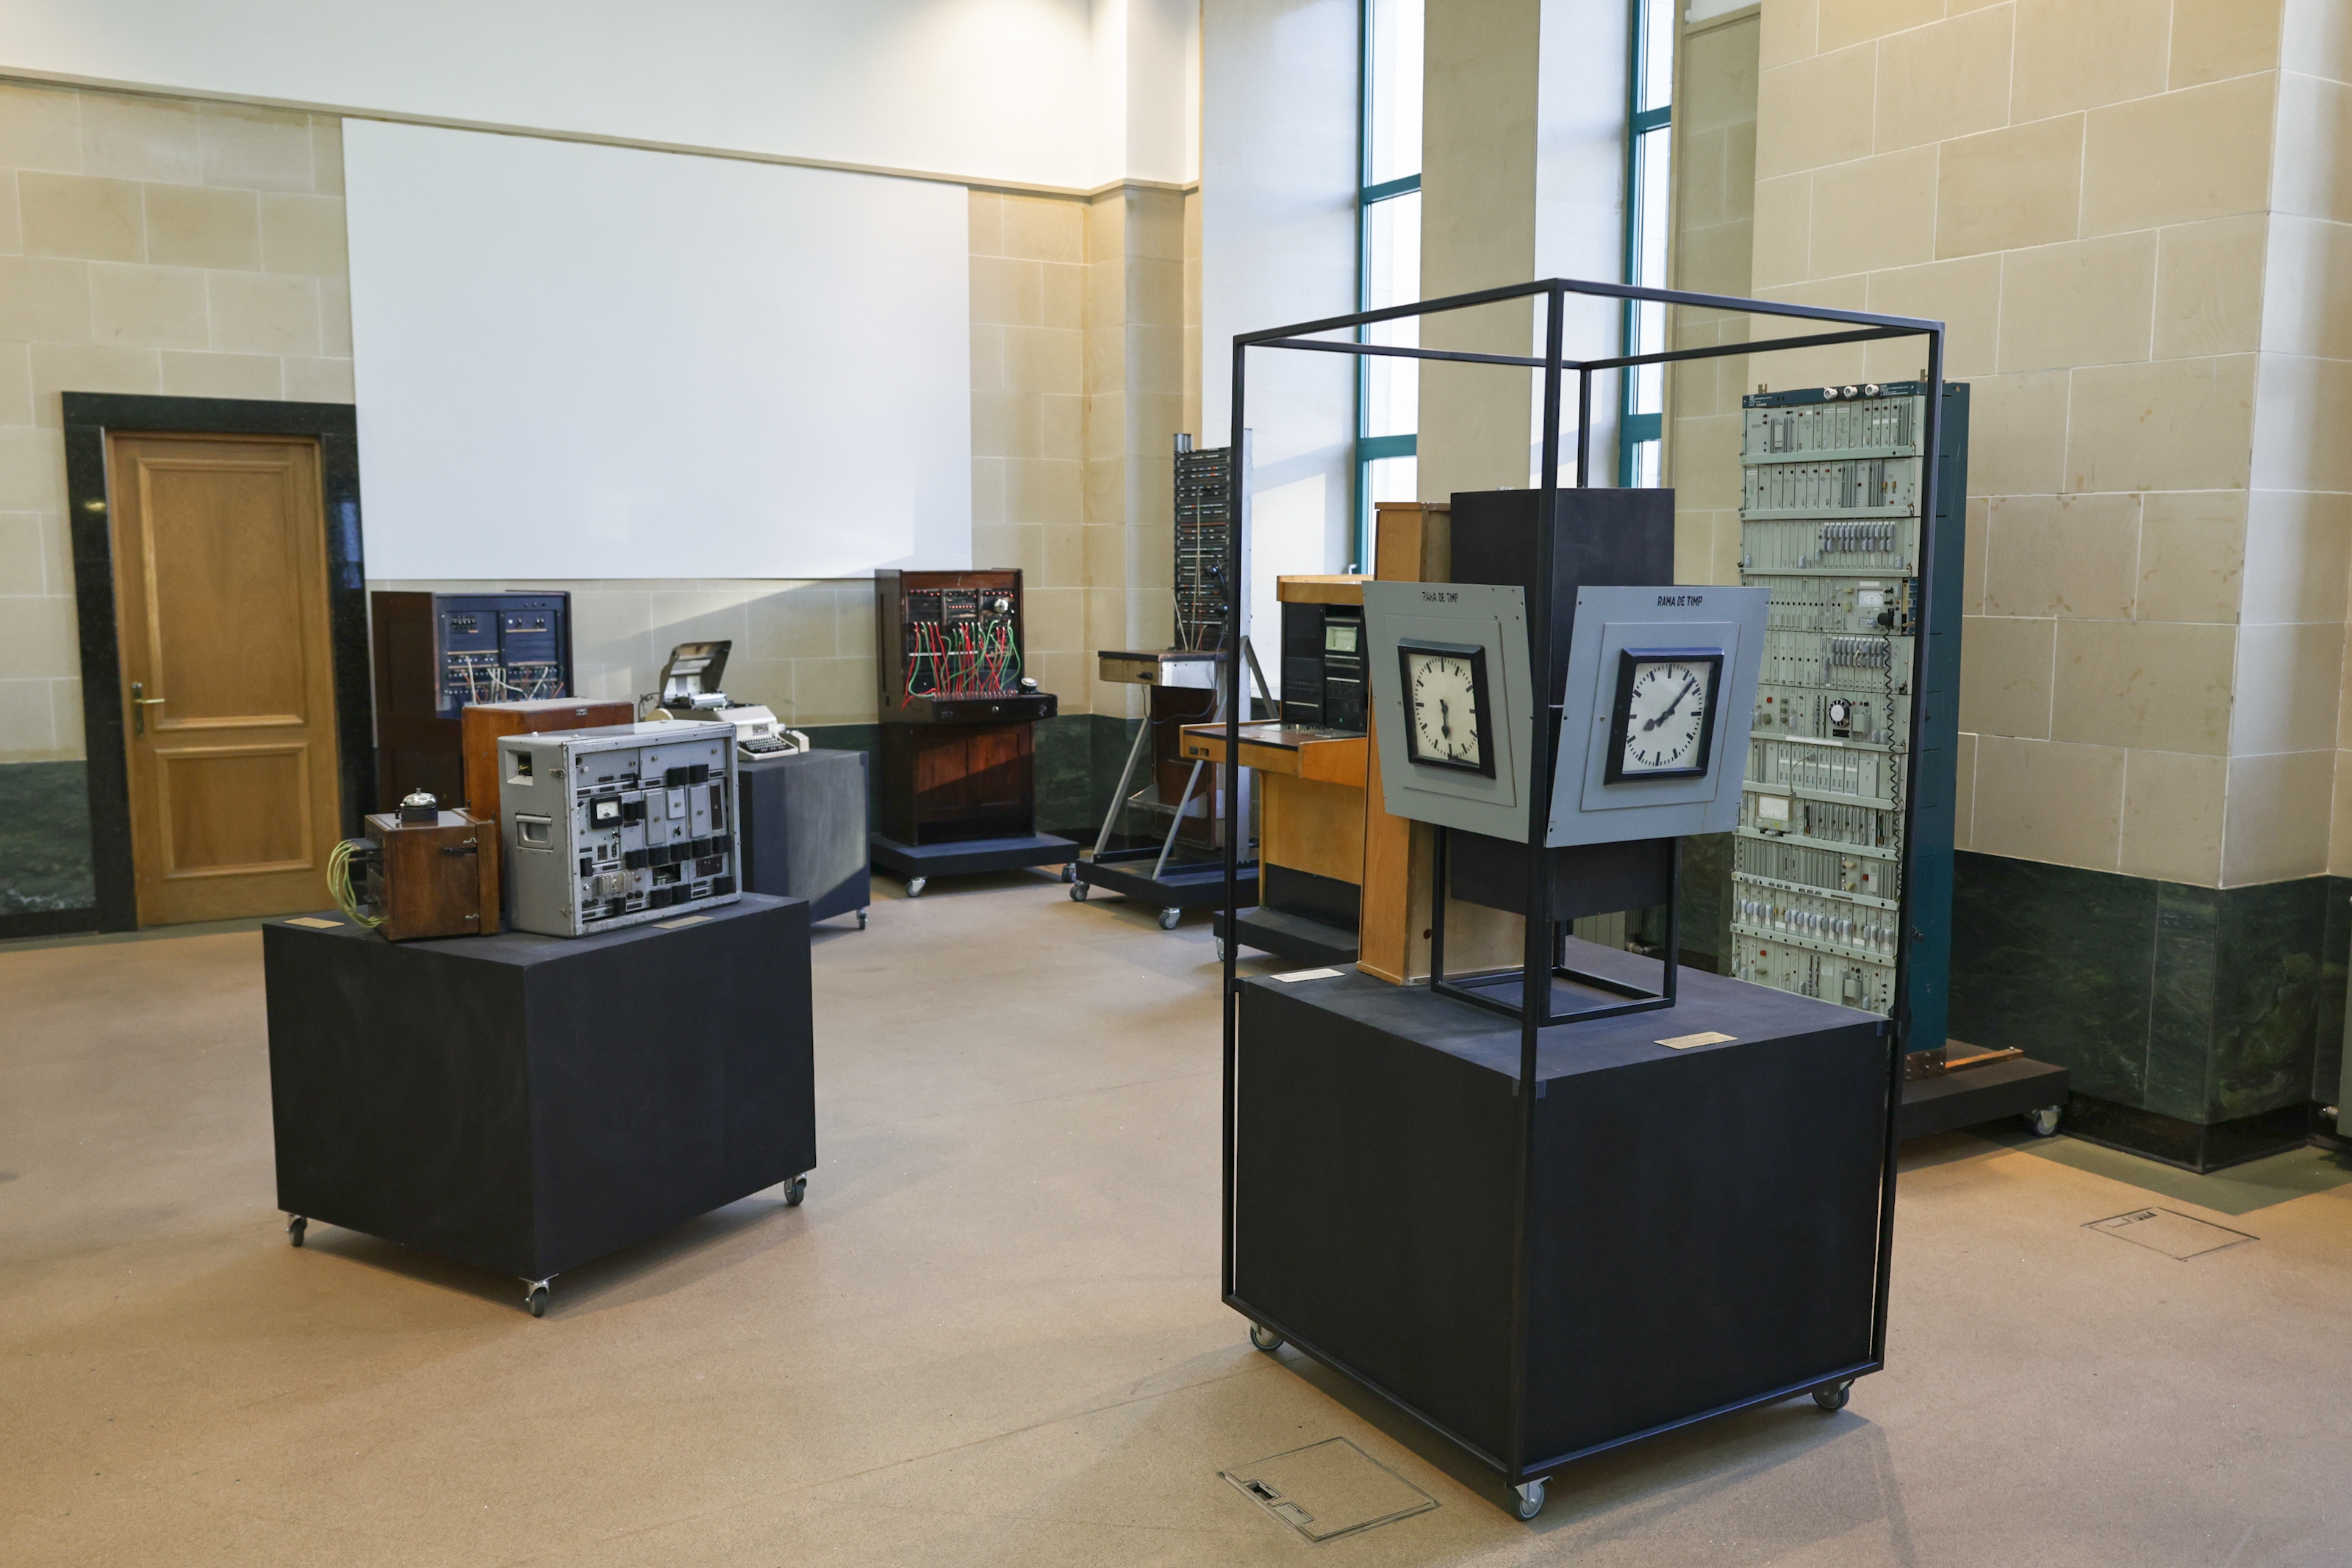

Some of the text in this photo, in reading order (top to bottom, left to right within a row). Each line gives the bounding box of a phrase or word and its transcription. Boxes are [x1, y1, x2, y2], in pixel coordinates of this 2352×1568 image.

[1422, 591, 1458, 603] RAMA DE TIMP
[1657, 596, 1703, 607] RAMA DE TIMP
